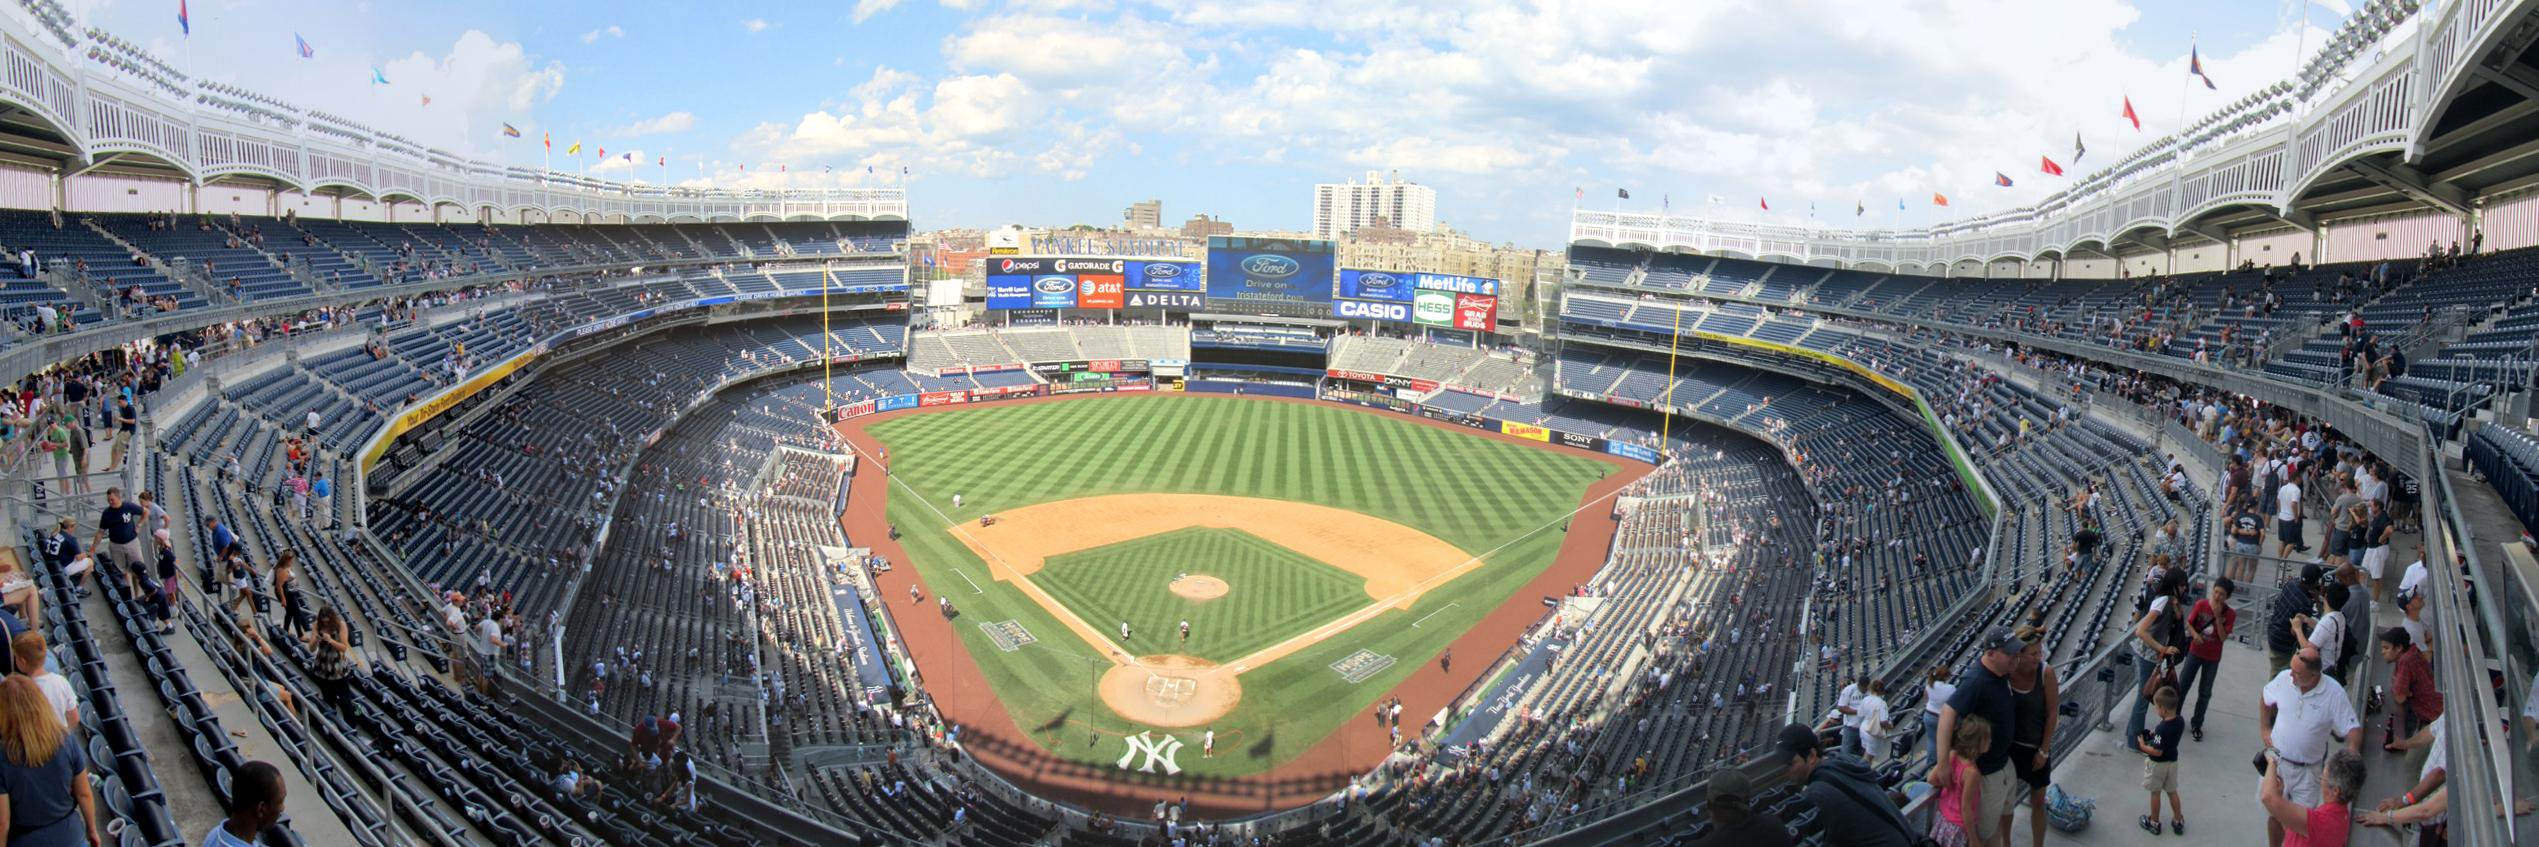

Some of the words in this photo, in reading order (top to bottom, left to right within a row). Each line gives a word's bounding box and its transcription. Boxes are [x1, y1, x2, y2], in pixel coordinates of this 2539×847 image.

[1031, 237, 1097, 255] YANKEE
[1106, 238, 1183, 257] STADIUM
[1015, 261, 1040, 270] pepsi
[1067, 262, 1111, 270] GATORADE
[1151, 264, 1174, 276] Ford
[1251, 257, 1289, 274] Ford
[1043, 280, 1067, 291] Ford
[1246, 279, 1272, 288] Drive
[1366, 275, 1390, 286] Ford
[1418, 275, 1477, 293] MetLife
[1097, 282, 1122, 294] at&t
[1147, 294, 1201, 307] DELTA
[1236, 291, 1304, 302] tristateford.com
[1340, 301, 1406, 320] CASIO
[1417, 301, 1451, 314] HESS
[1463, 320, 1486, 329] BUDS
[1348, 372, 1376, 381] TOYOTA
[1384, 377, 1412, 387] DKNY
[839, 402, 875, 420] Canon
[1563, 432, 1593, 444] SONY
[2405, 484, 2418, 494] 25
[1115, 729, 1185, 776] NY
